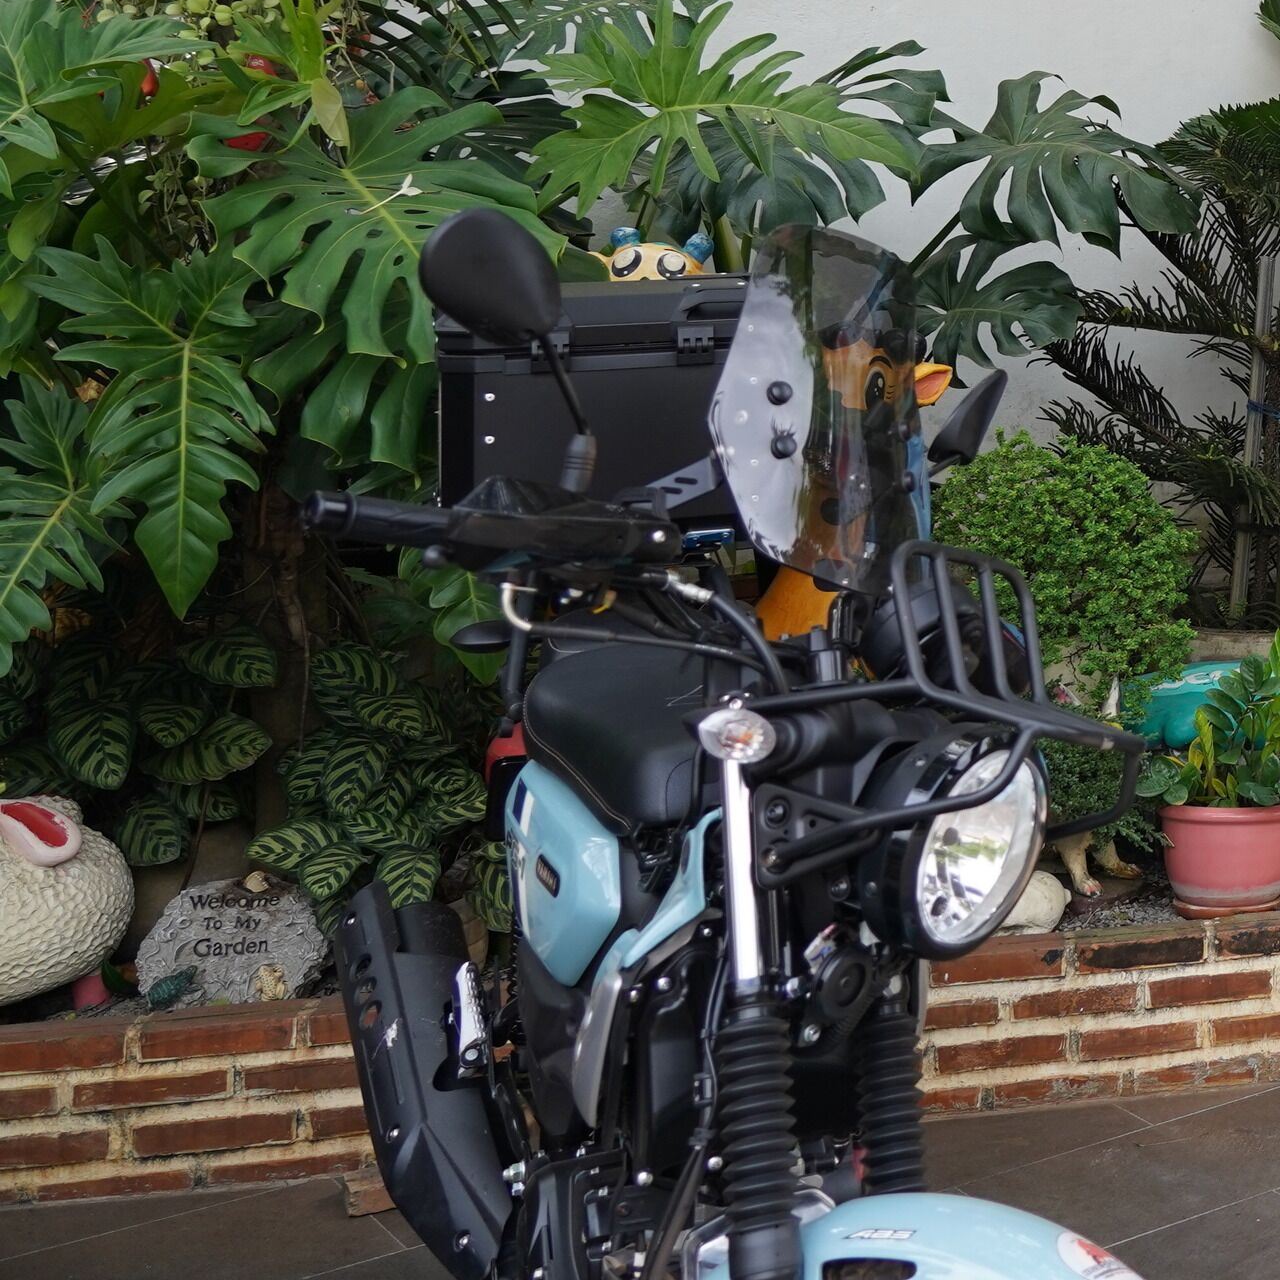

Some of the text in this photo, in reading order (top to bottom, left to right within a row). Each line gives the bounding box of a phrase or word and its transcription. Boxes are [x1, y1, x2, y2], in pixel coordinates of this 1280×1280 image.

[189, 893, 281, 911] Welcome
[203, 915, 262, 931] To My
[193, 936, 269, 958] Garden
